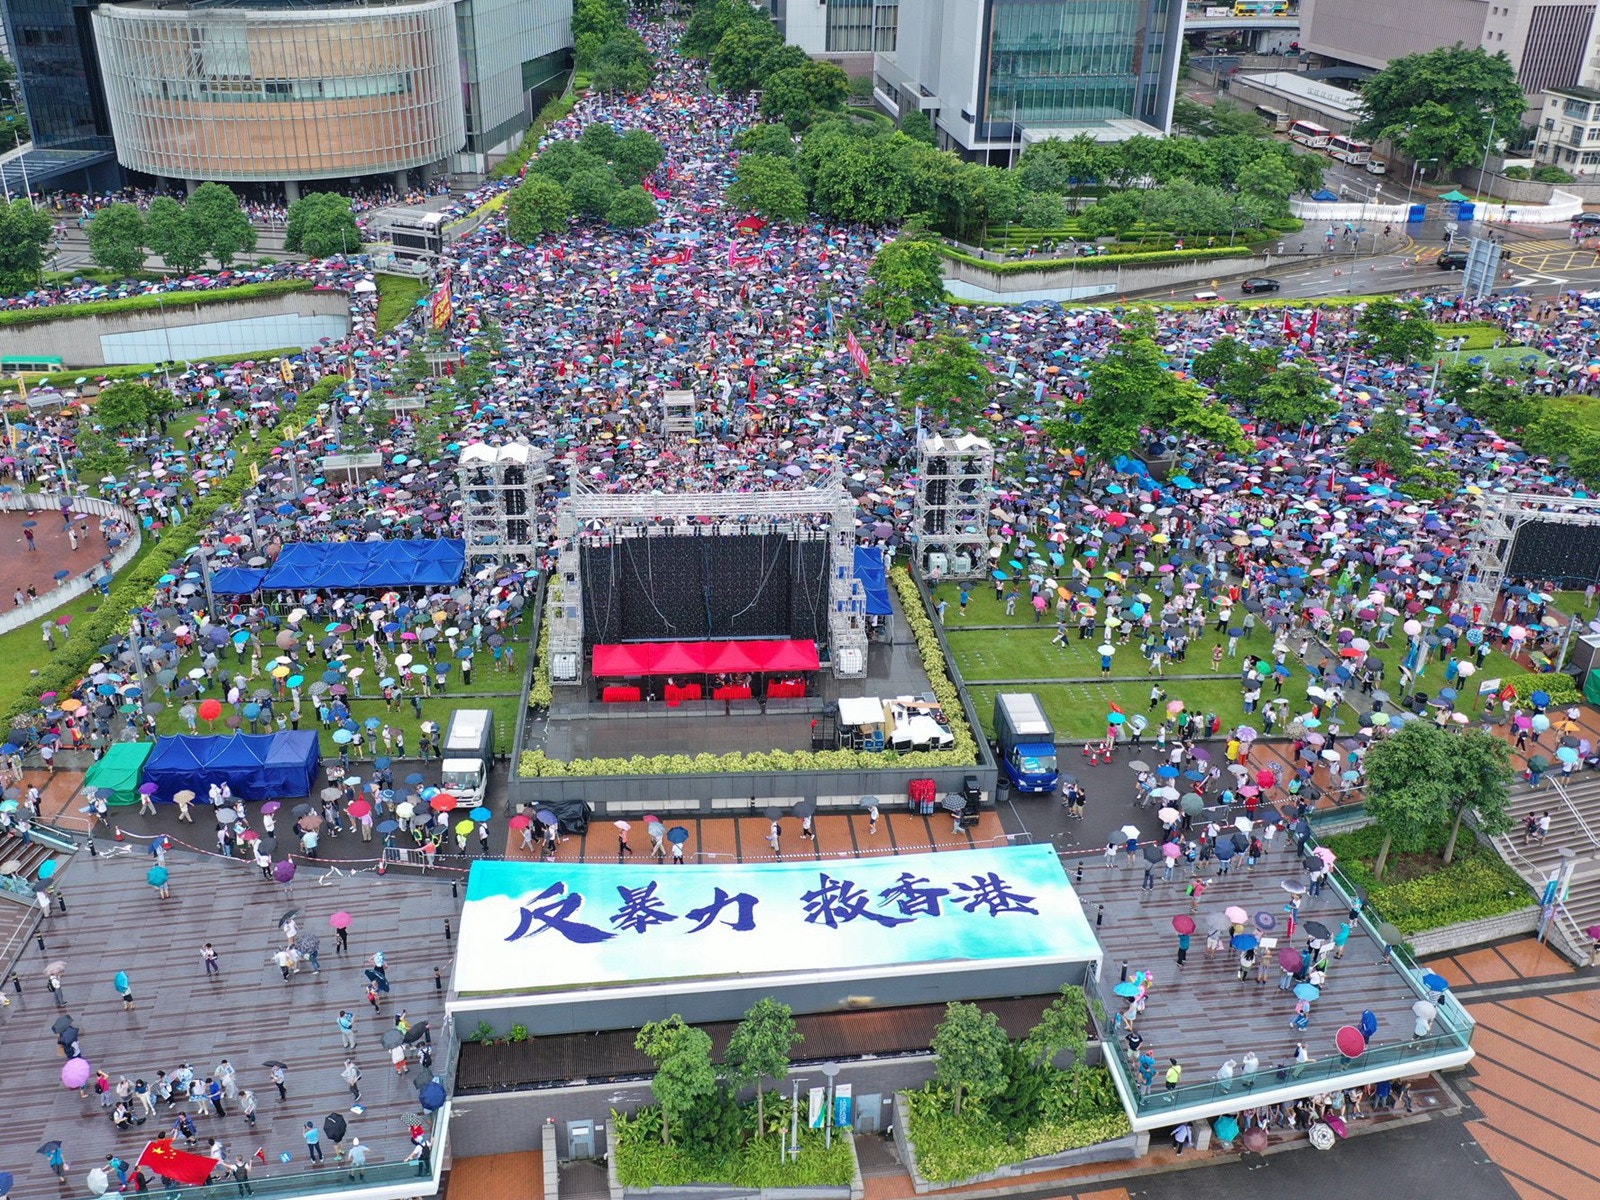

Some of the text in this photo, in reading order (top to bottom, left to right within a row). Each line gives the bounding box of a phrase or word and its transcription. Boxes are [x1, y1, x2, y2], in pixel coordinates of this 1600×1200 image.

[504, 872, 1040, 944] 反暴力 救香港
